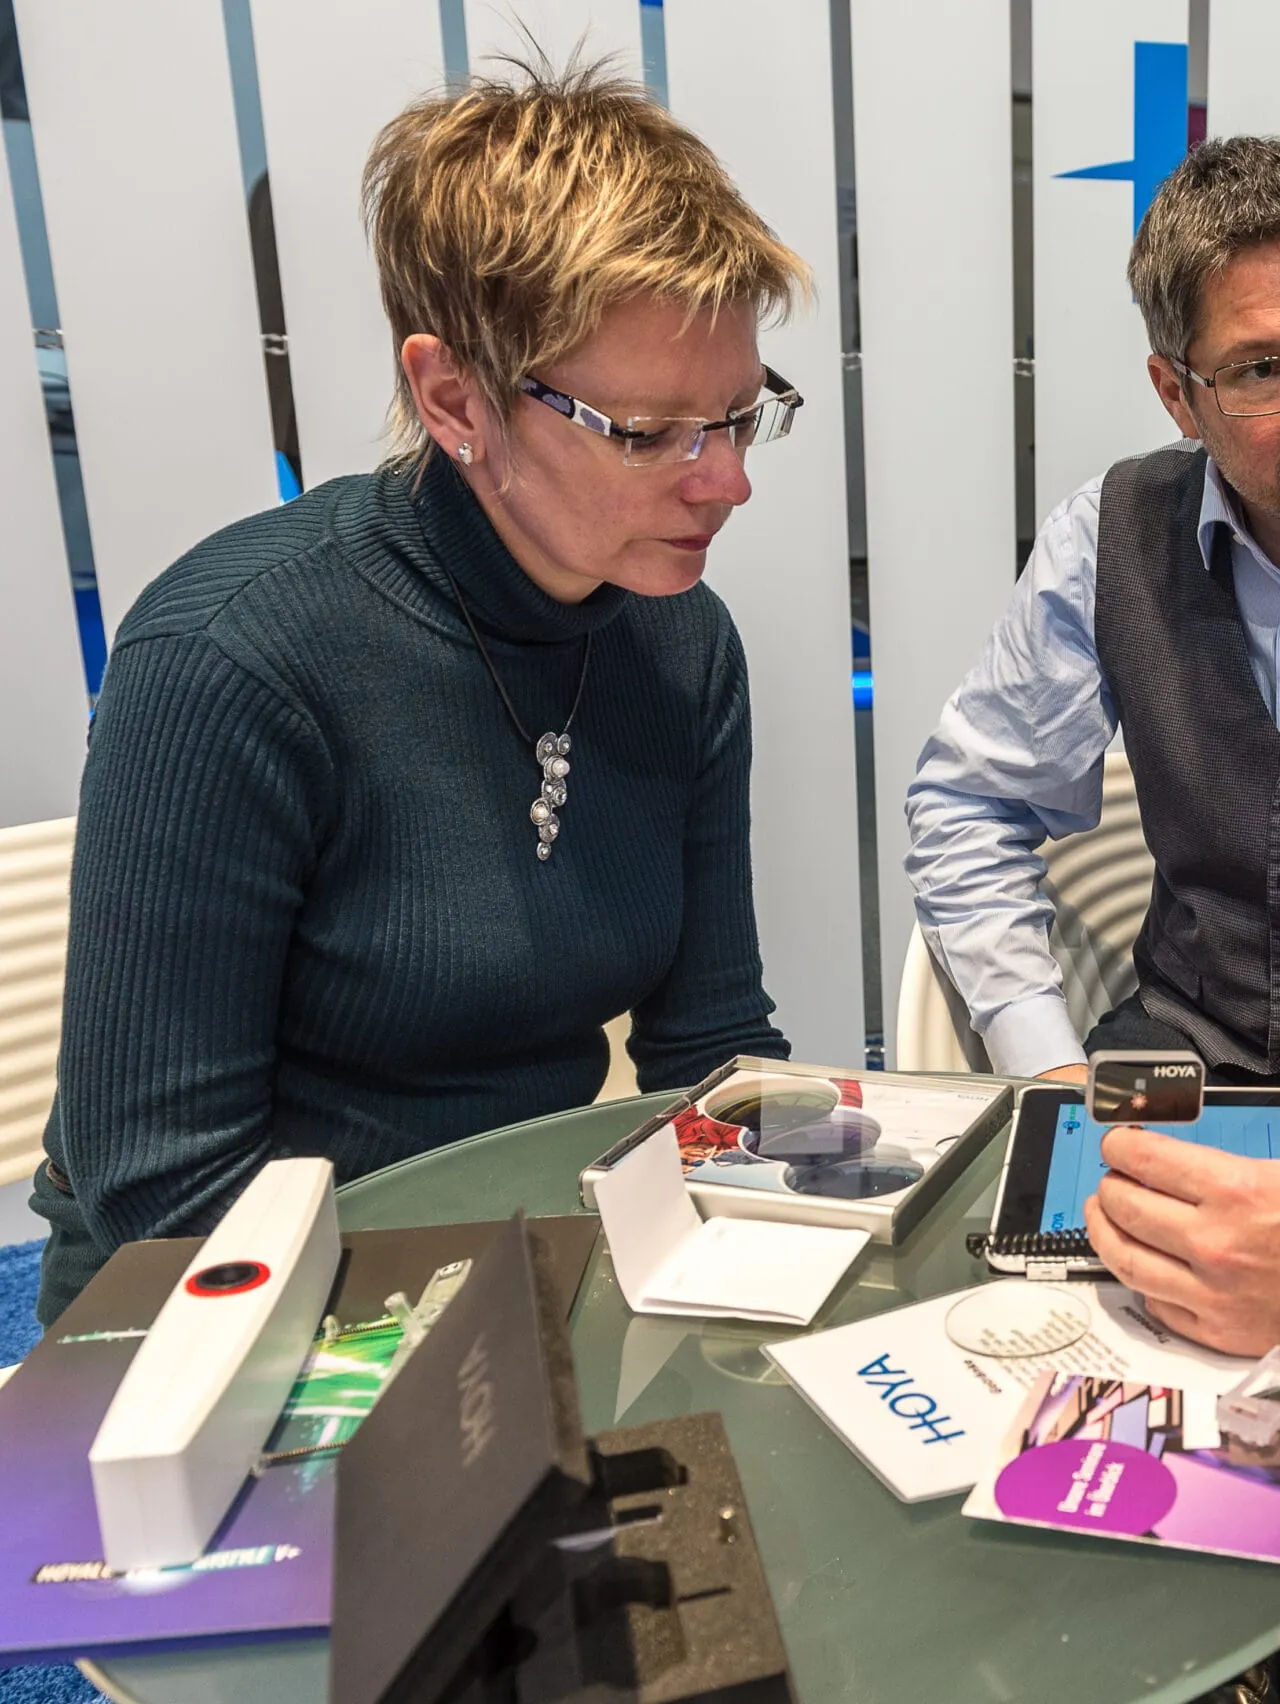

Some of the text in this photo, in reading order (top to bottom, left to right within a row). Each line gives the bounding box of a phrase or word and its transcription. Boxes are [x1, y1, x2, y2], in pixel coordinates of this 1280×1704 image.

[1153, 1065, 1197, 1078] HOYA
[1051, 1211, 1065, 1231] OYA
[857, 1353, 966, 1445] HOYA
